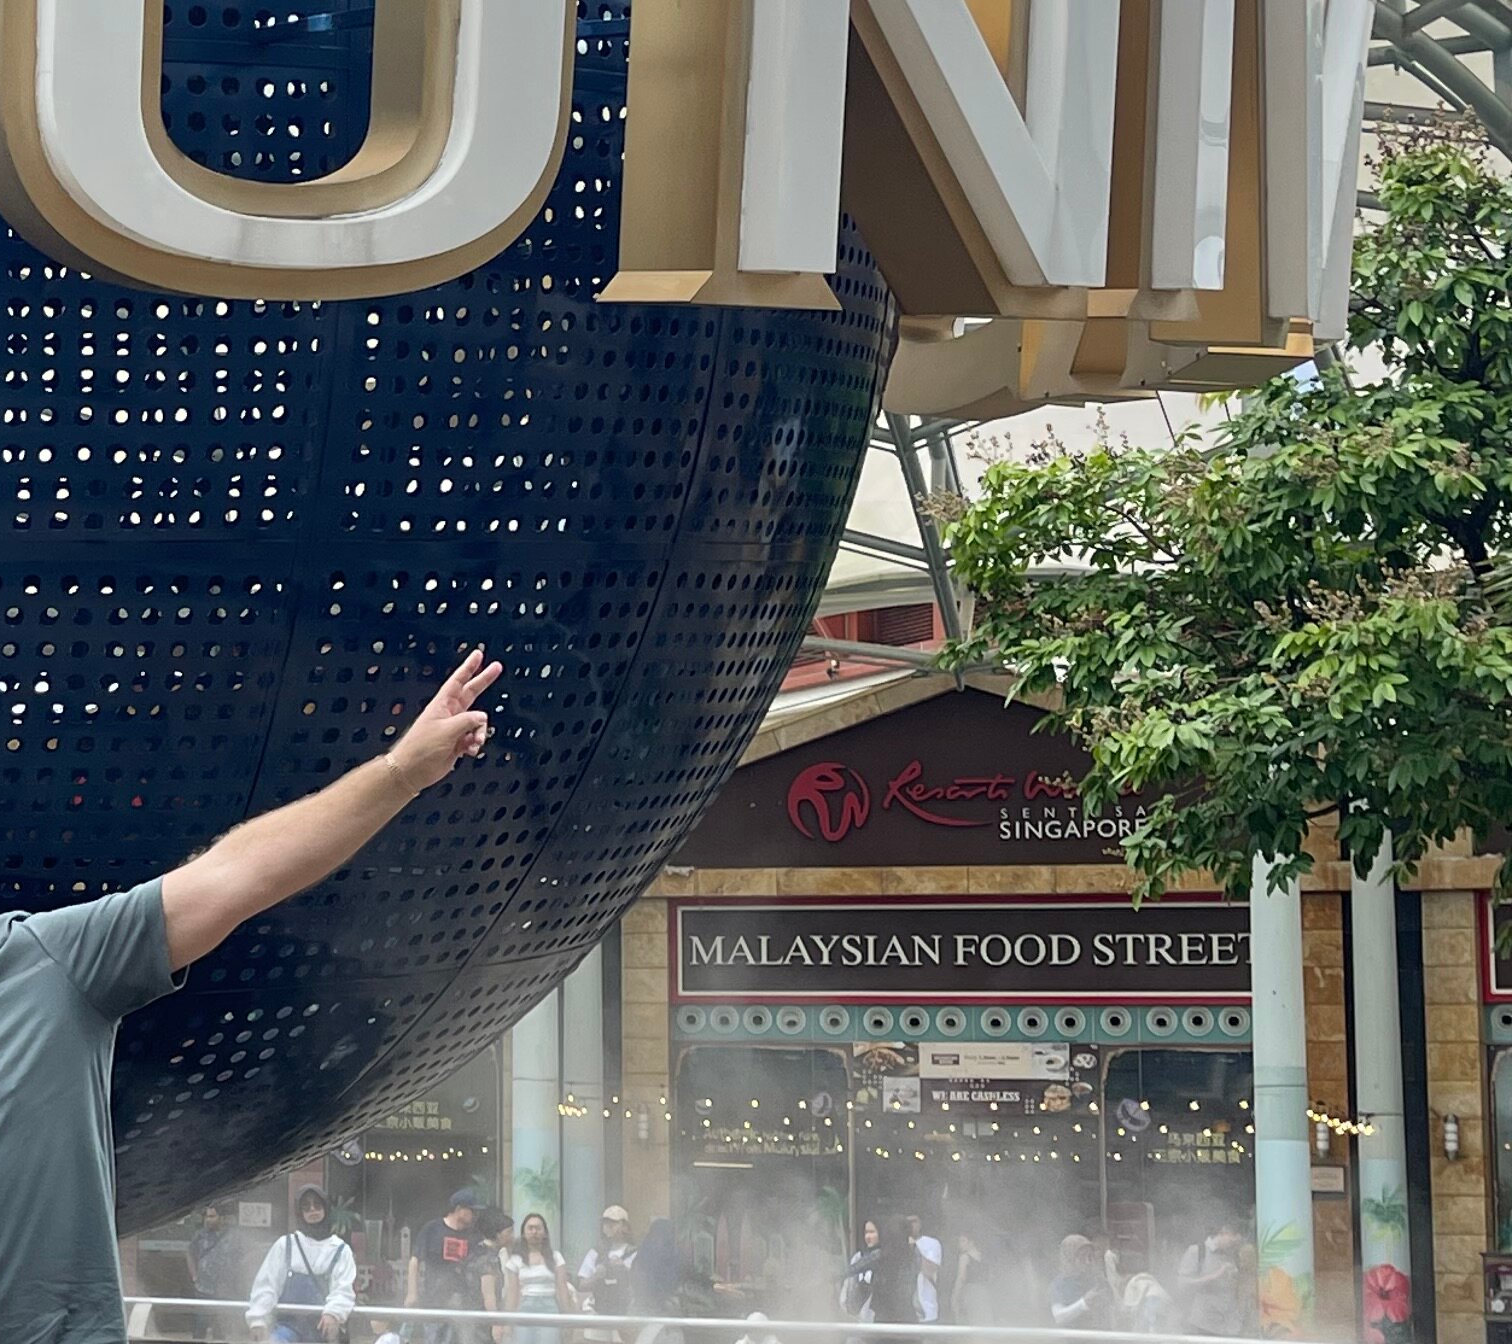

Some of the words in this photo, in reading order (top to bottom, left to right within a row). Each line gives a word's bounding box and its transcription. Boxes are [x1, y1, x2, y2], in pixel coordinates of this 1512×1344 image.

[884, 760, 1015, 826] Resorts
[1000, 805, 1147, 820] SENTSA
[689, 934, 942, 966] MALAYSIAN
[953, 933, 1081, 966] FOOD
[949, 1090, 969, 1101] ARE
